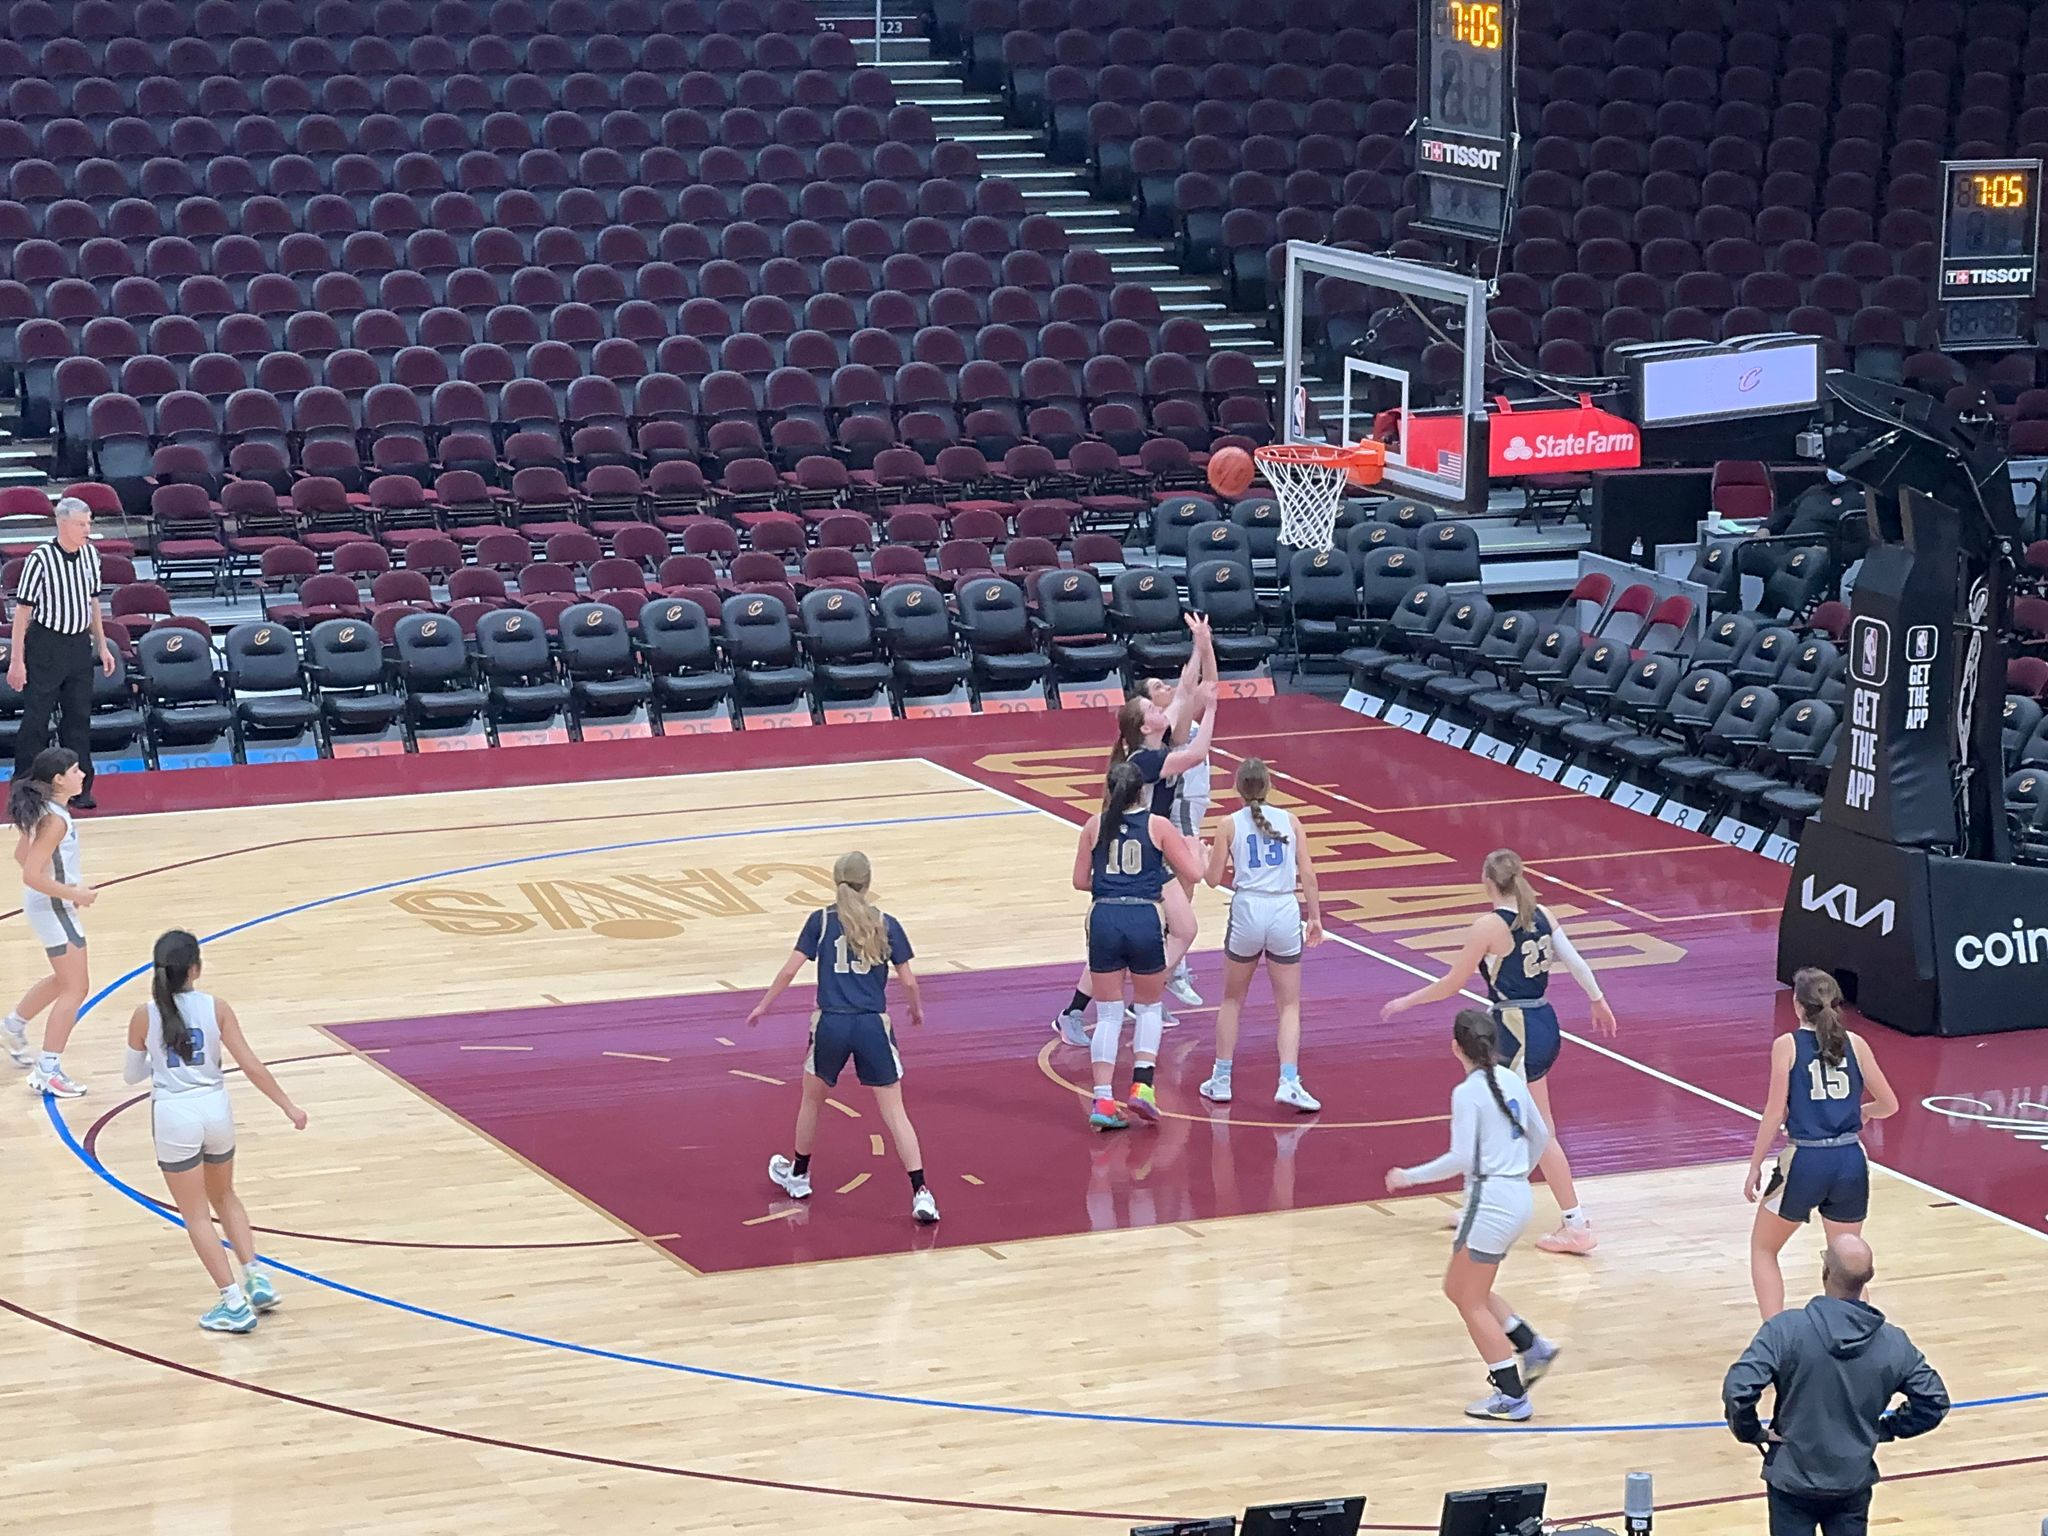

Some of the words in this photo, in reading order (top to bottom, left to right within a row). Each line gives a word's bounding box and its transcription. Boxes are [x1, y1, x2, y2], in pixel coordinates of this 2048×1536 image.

[1450, 1, 1500, 49] 7:05
[1442, 145, 1501, 171] TISSOT
[1973, 175, 2024, 208] 7:05
[1970, 267, 2032, 284] TISSOT
[1909, 664, 1931, 686] GET
[1359, 697, 1369, 714] 1
[1908, 686, 1930, 708] THE
[1399, 711, 1414, 728] 2
[1852, 687, 1881, 730] GET
[1905, 708, 1929, 730] APP
[1443, 727, 1457, 744] 3
[1486, 744, 1500, 760] 4
[1851, 728, 1878, 771] THE
[1532, 757, 1548, 775] 5
[1577, 774, 1593, 793] 6
[1845, 769, 1876, 811] APP
[1626, 790, 1644, 809] 7
[1674, 808, 1690, 827] 8
[1730, 826, 1747, 846] 9
[1105, 839, 1142, 875] 10
[1246, 833, 1284, 868] 13
[1776, 842, 1798, 865] 10
[1521, 935, 1551, 978] 23
[1808, 1056, 1850, 1101] 15
